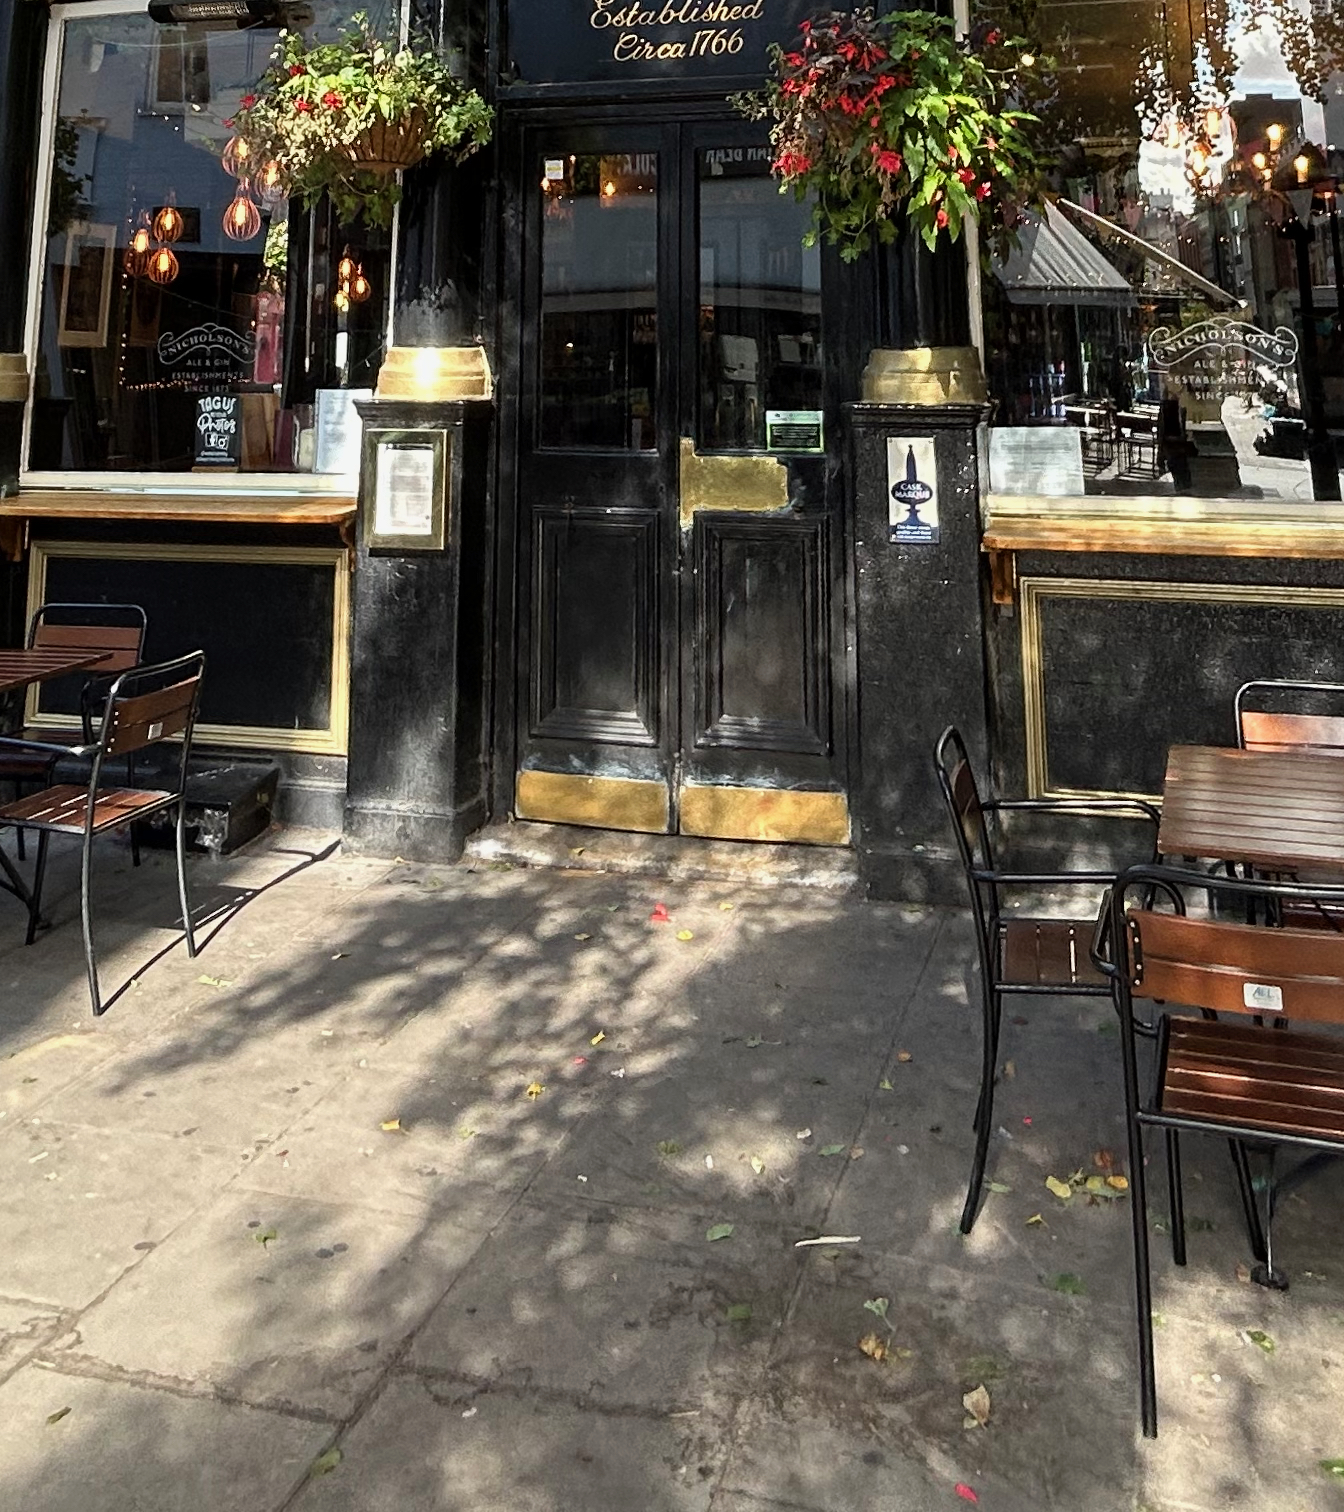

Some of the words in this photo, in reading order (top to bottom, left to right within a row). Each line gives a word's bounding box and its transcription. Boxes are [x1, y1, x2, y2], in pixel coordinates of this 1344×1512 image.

[613, 32, 686, 62] Circa
[688, 28, 744, 57] 1766
[167, 333, 250, 356] NICHOLSON'S
[1164, 329, 1285, 356] NICHOLSON'S
[1194, 360, 1217, 368] ALE
